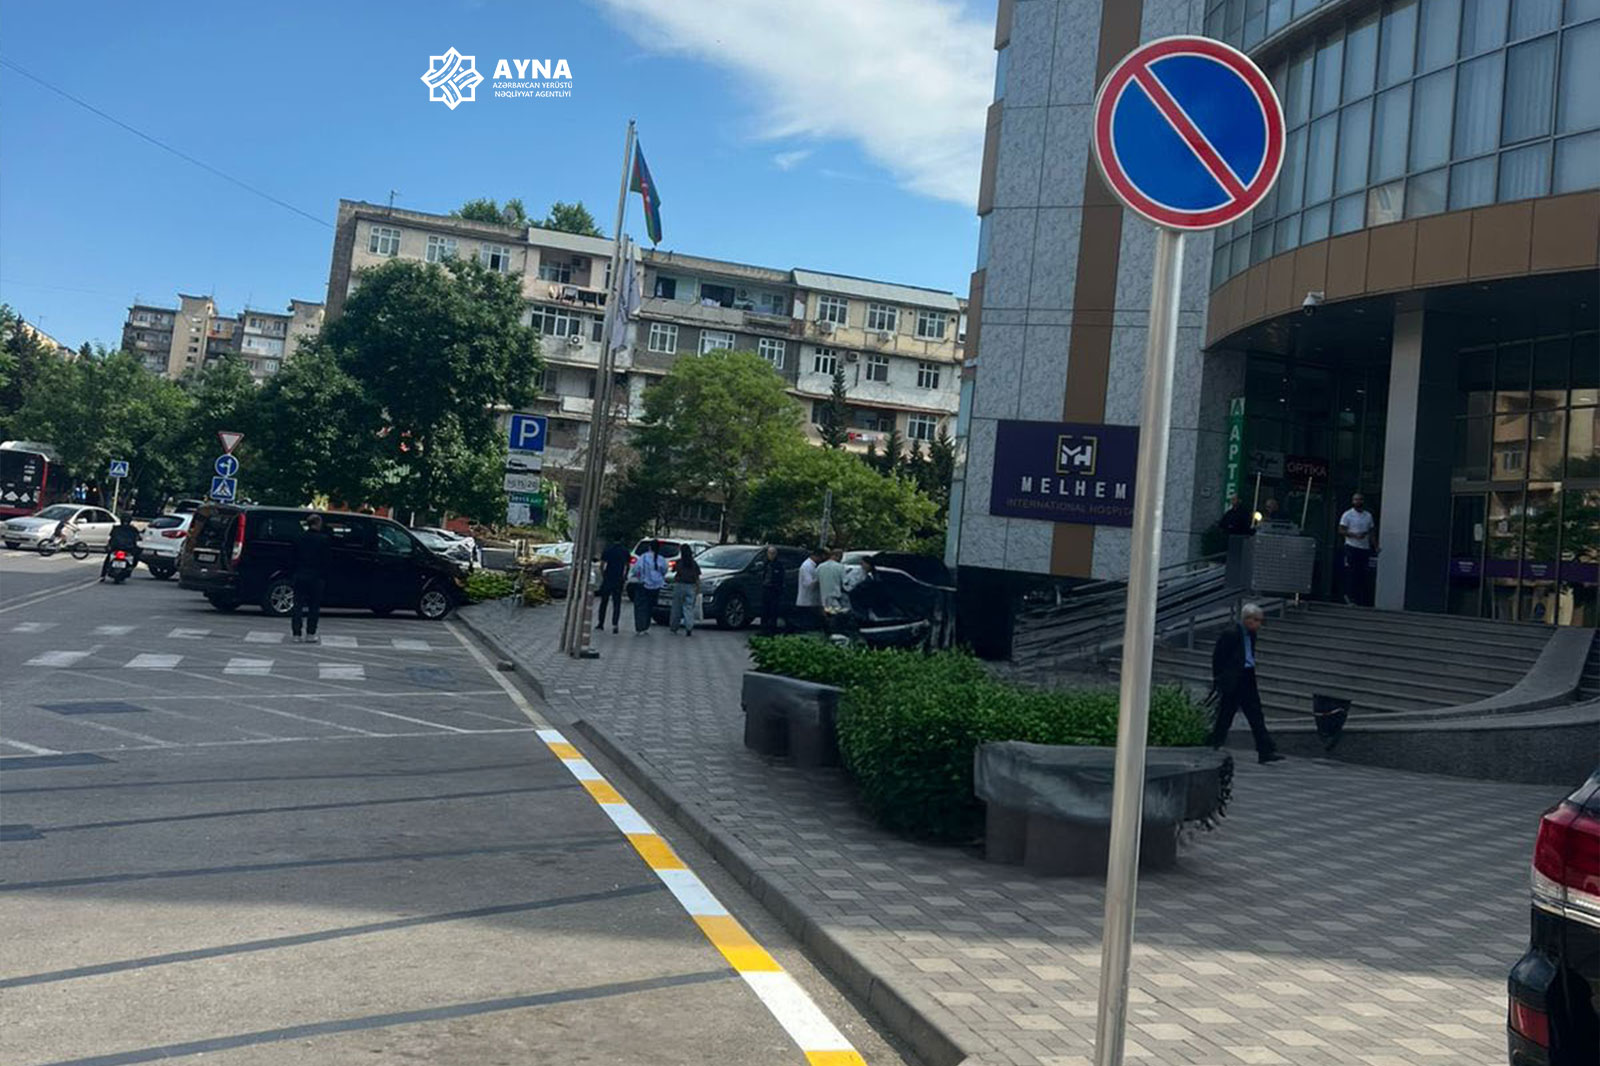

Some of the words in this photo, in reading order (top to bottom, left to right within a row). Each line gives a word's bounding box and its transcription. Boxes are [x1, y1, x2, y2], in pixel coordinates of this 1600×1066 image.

[518, 419, 540, 447] P
[1021, 476, 1127, 500] MELHEM
[1006, 498, 1086, 513] INTERNATIONAL
[1089, 504, 1134, 517] HOSPIT
